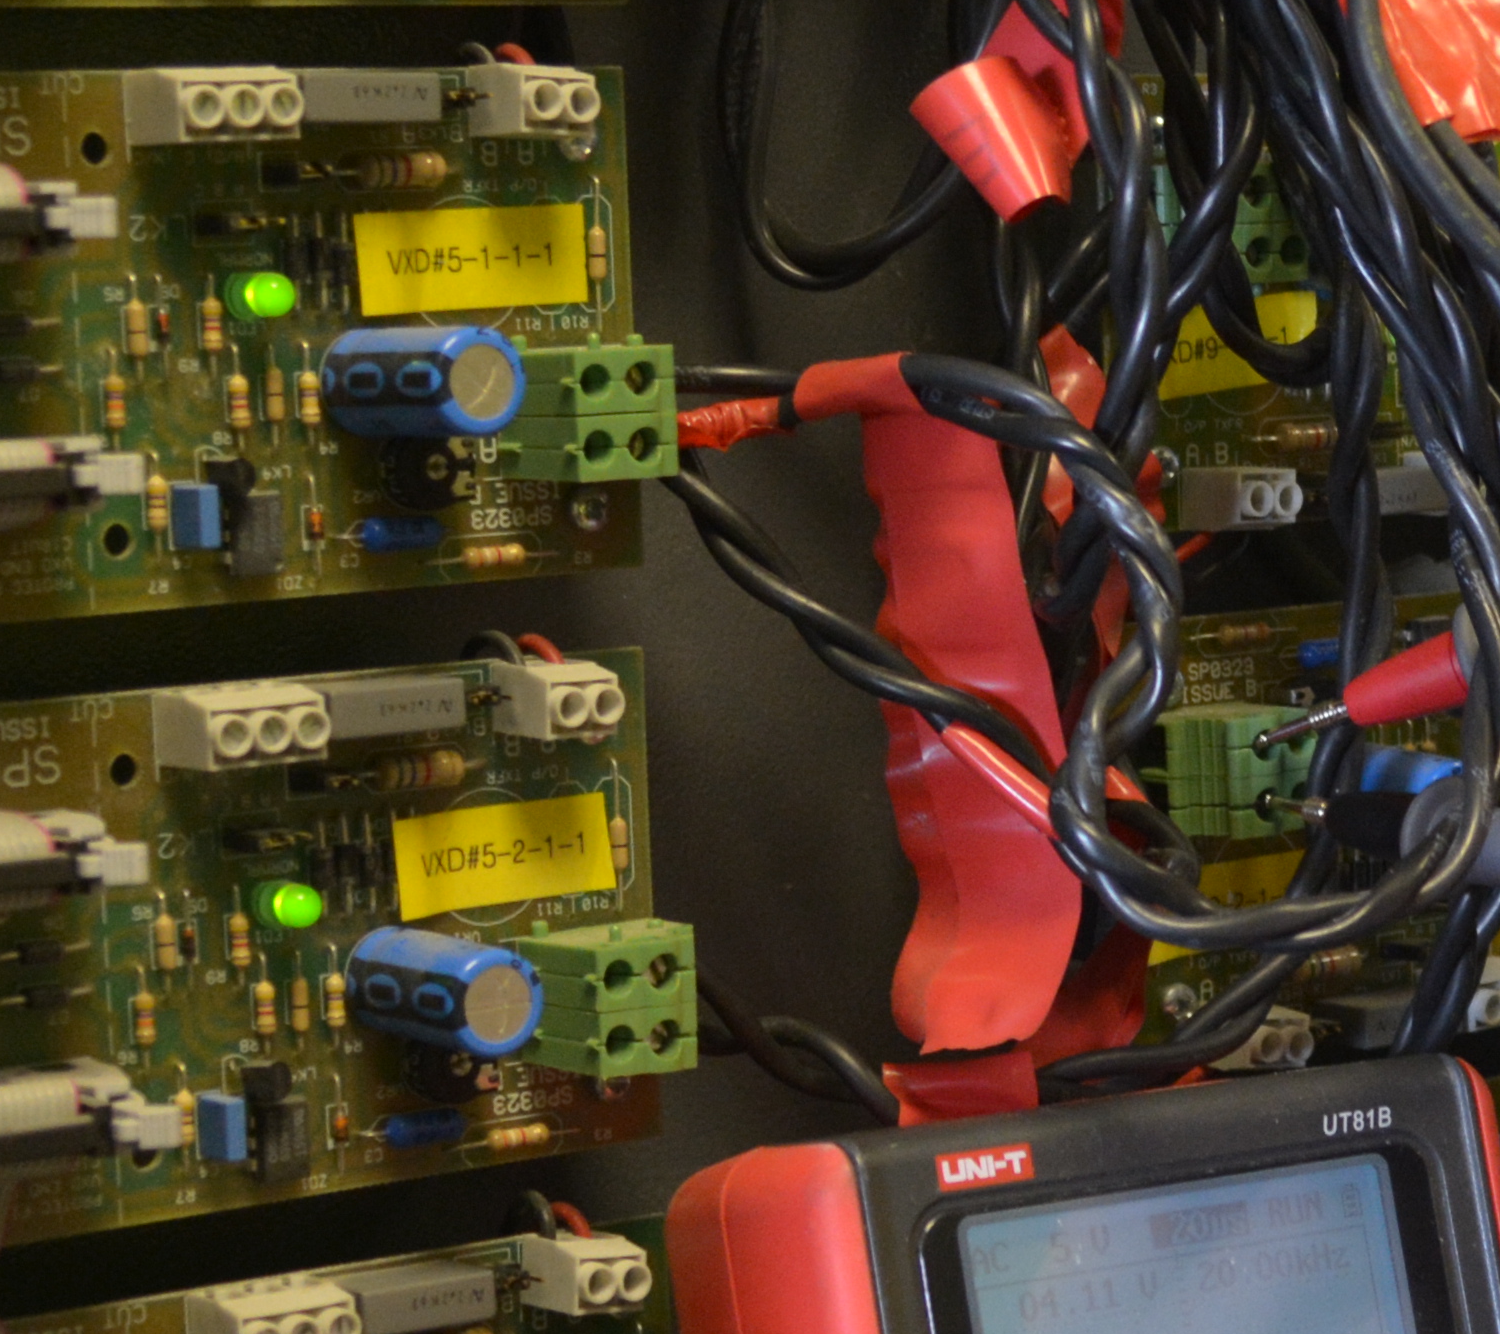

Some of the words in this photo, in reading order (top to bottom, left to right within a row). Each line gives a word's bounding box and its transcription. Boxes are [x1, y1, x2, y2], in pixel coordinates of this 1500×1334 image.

[41, 73, 85, 95] CUT
[480, 142, 499, 166] B
[516, 141, 534, 165] A
[386, 244, 552, 275] VXD#5-1-1-1
[561, 314, 588, 329] R10
[479, 437, 497, 461] A
[1185, 443, 1200, 466] A
[1215, 442, 1229, 464] B
[492, 482, 560, 503] ISSUE
[470, 507, 553, 530] SP0323
[1188, 657, 1254, 682] SP0323
[1182, 681, 1234, 704] ISSUE
[1246, 679, 1257, 697] B
[70, 697, 114, 722] CUT
[421, 832, 585, 877] VXD#5-2-1-1
[536, 900, 563, 917] R11
[581, 896, 609, 912] R10
[492, 1087, 574, 1114] SP0323
[1322, 1107, 1393, 1136] UT81B
[941, 1151, 1027, 1183] UNI-T
[972, 1242, 1010, 1276] AC
[1268, 1191, 1323, 1227] RUN
[1018, 1285, 1120, 1323] 04.11
[1198, 1243, 1352, 1291] 20.00kHz
[103, 1302, 147, 1330] CUT
